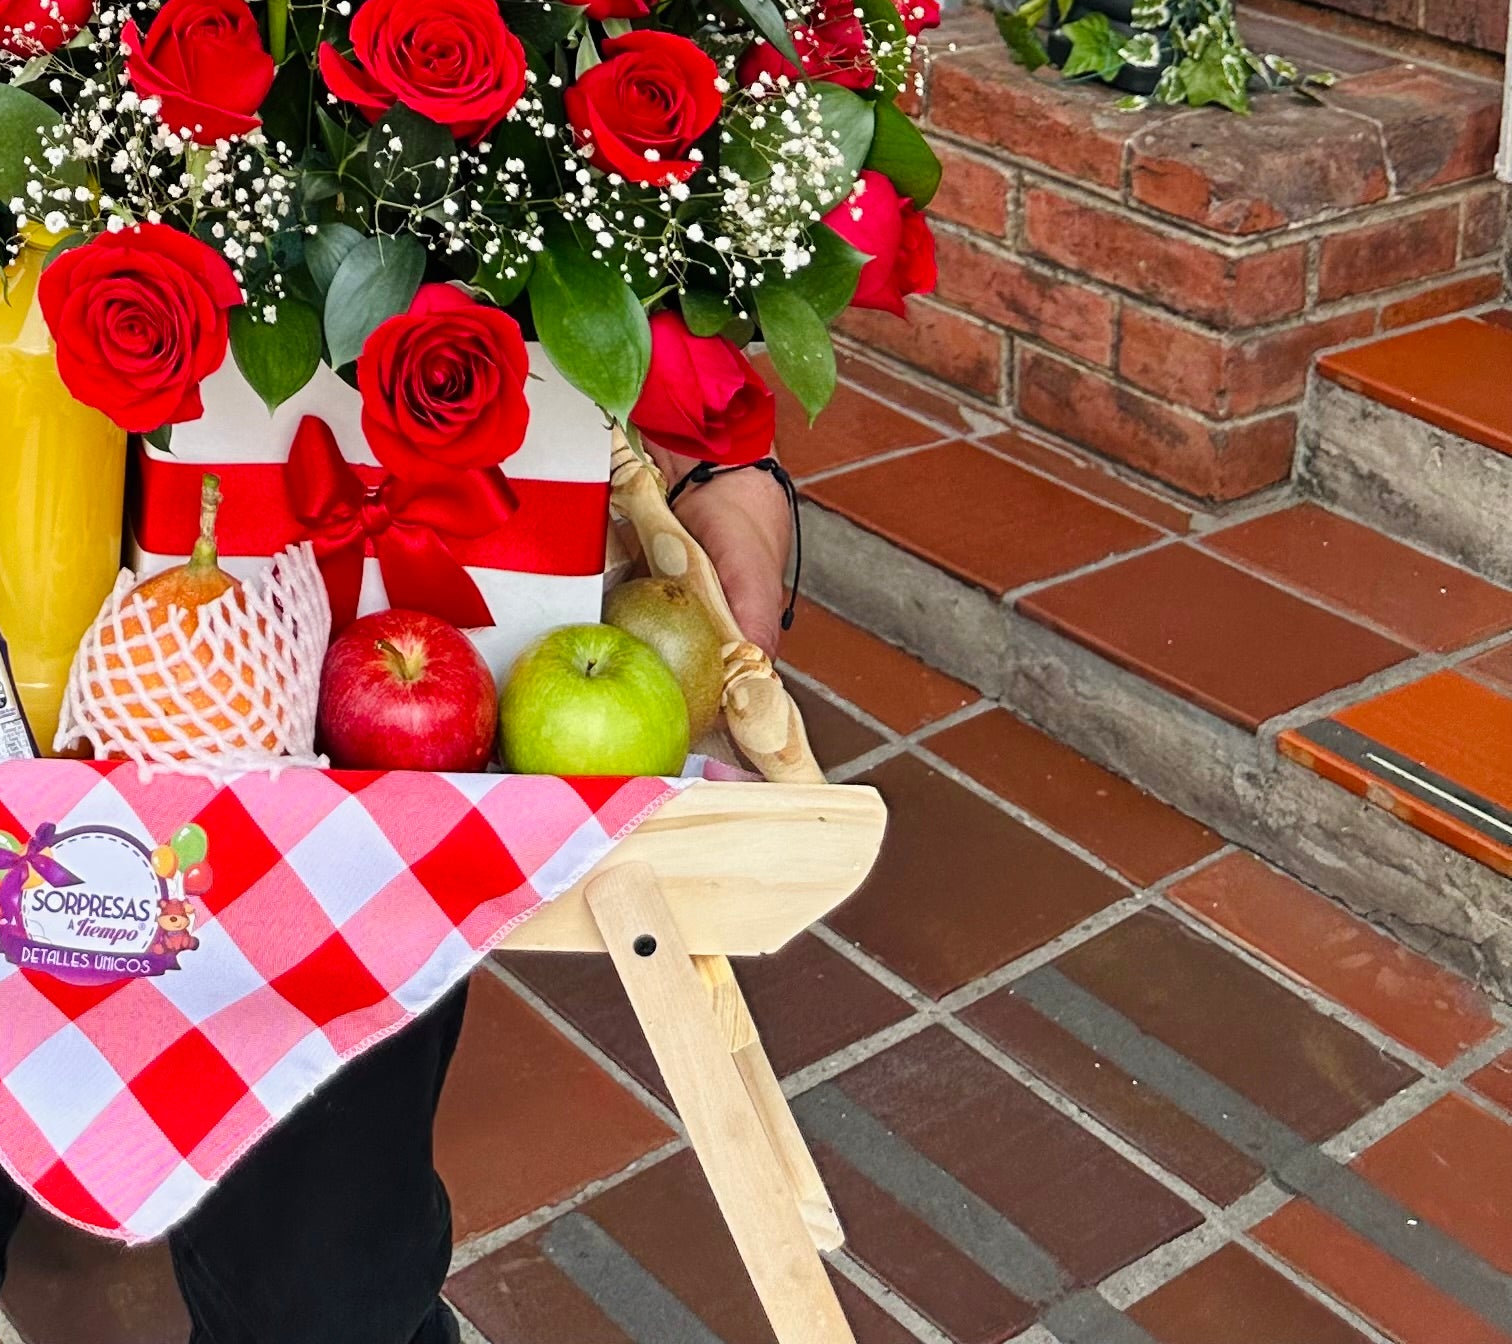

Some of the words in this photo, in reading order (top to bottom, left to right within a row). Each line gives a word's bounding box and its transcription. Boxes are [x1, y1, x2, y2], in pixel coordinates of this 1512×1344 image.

[31, 889, 151, 922] SORPRESAS
[67, 918, 75, 930] A
[75, 917, 139, 946] Tiempo
[21, 946, 90, 968] DETALLES
